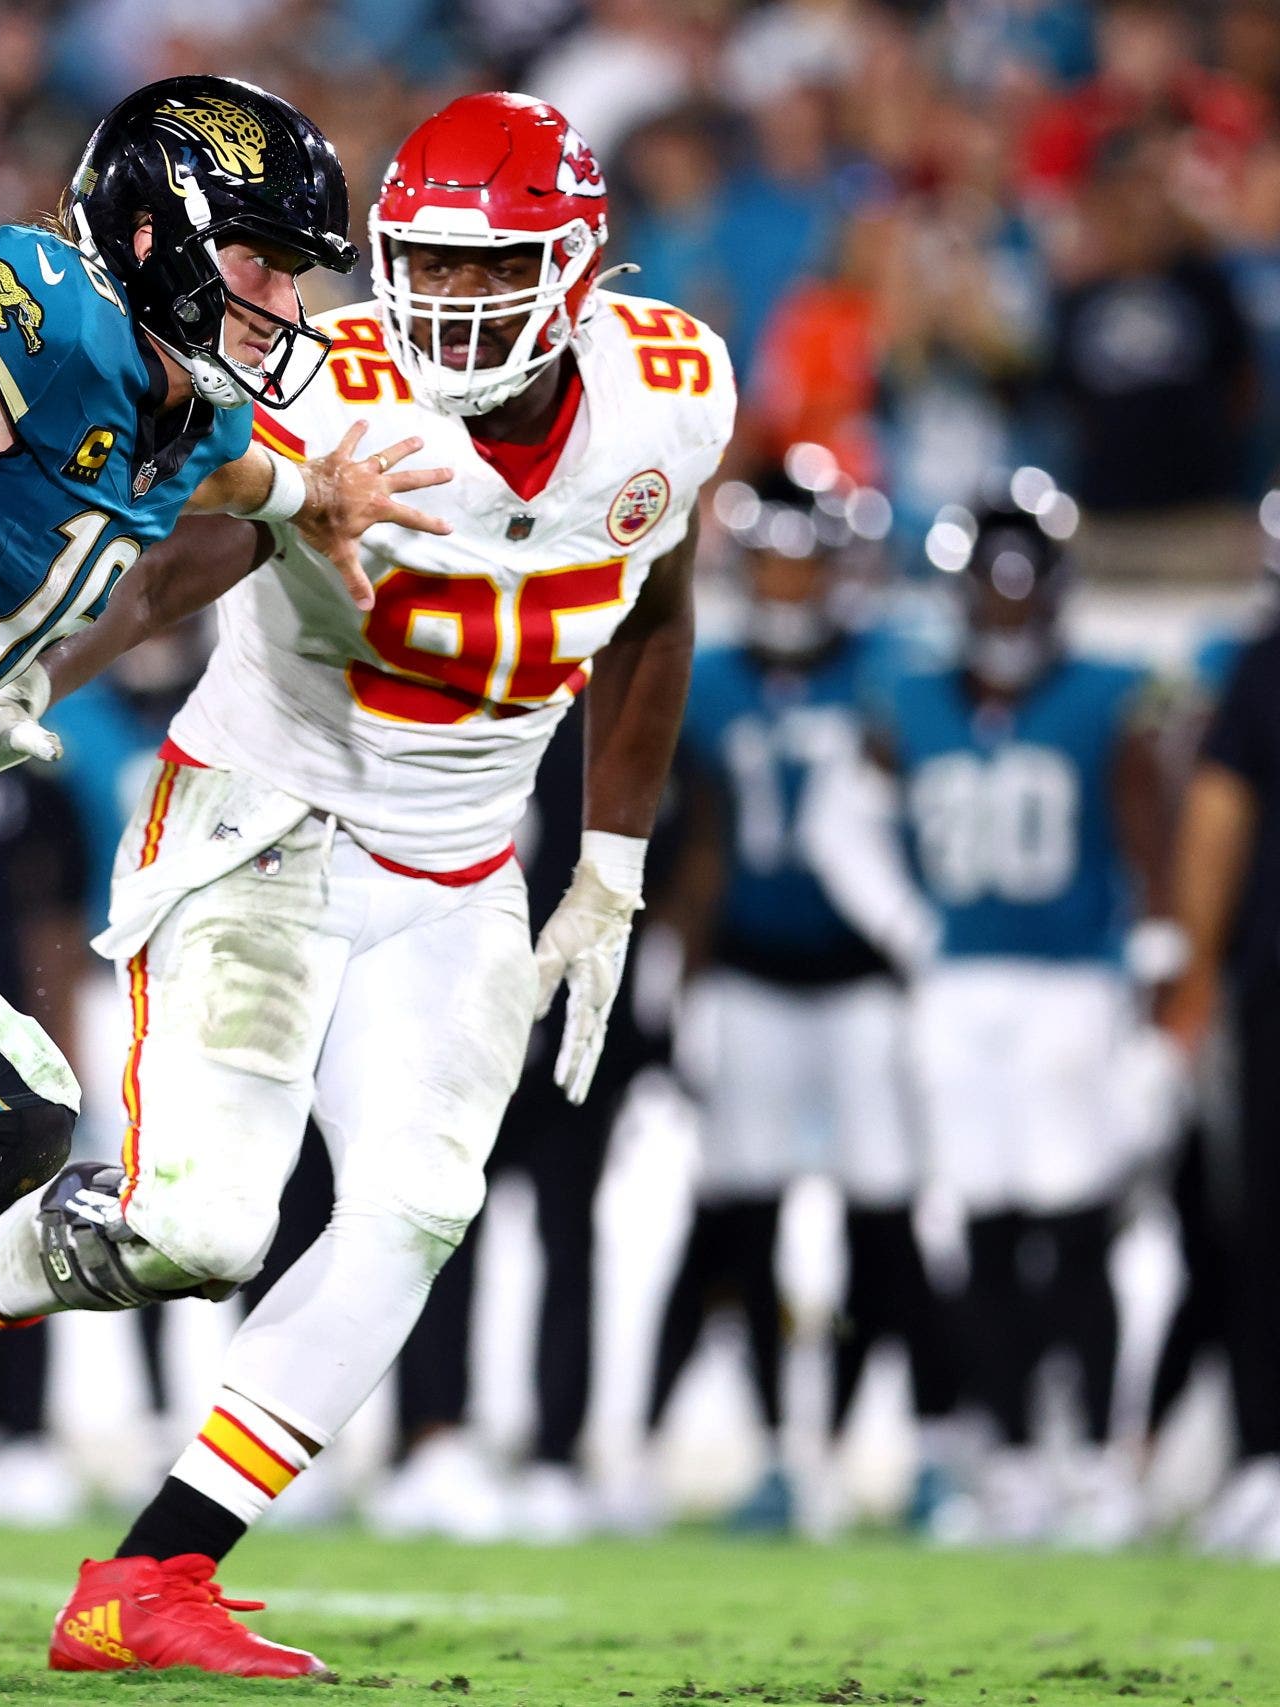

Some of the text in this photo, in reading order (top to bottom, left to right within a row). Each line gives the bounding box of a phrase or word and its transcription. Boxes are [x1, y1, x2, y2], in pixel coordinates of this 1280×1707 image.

[316, 317, 417, 404] 95
[609, 302, 715, 396] 95
[76, 430, 114, 469] C
[344, 554, 630, 725] 95
[63, 1618, 135, 1663] adidas
